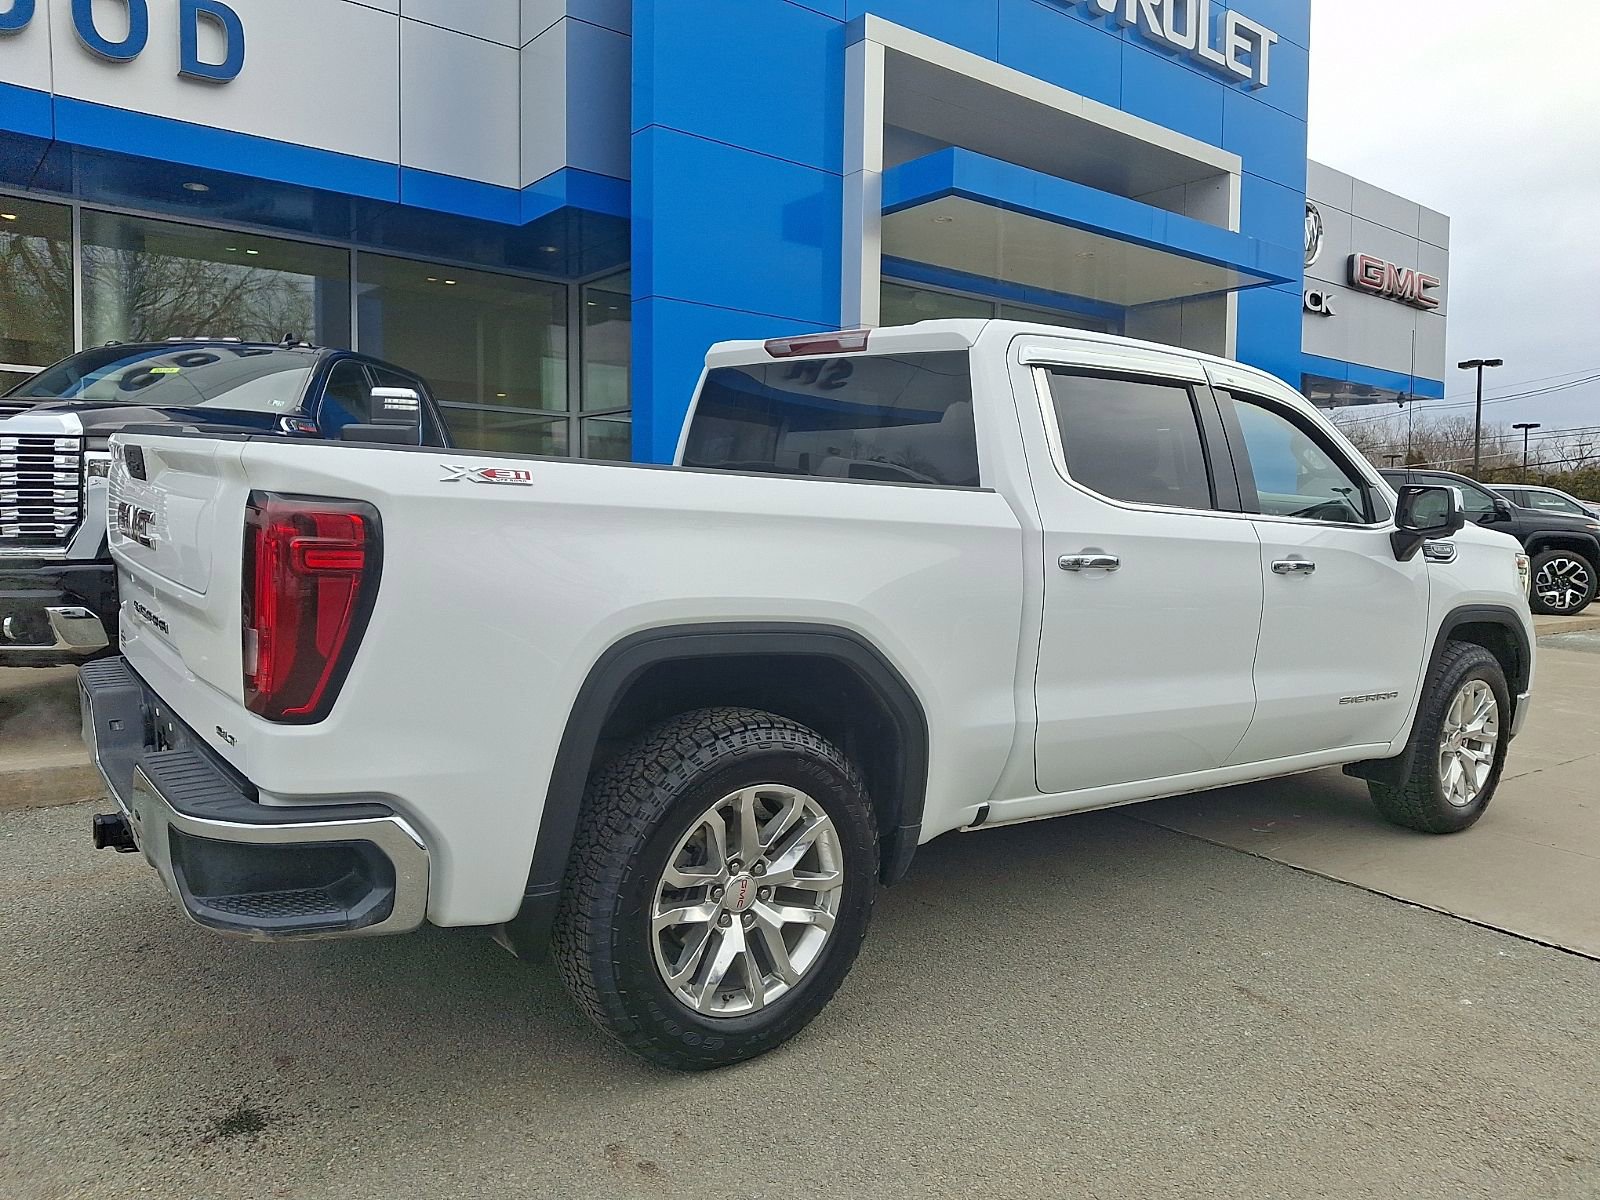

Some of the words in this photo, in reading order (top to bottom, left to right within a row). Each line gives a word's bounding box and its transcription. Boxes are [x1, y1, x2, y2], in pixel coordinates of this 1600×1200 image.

[0, 0, 246, 83] OD
[1097, 0, 1278, 87] OLET
[1355, 252, 1441, 309] GMC
[1339, 690, 1399, 704] SIERRA
[215, 725, 238, 747] SLT
[736, 878, 748, 909] GMC
